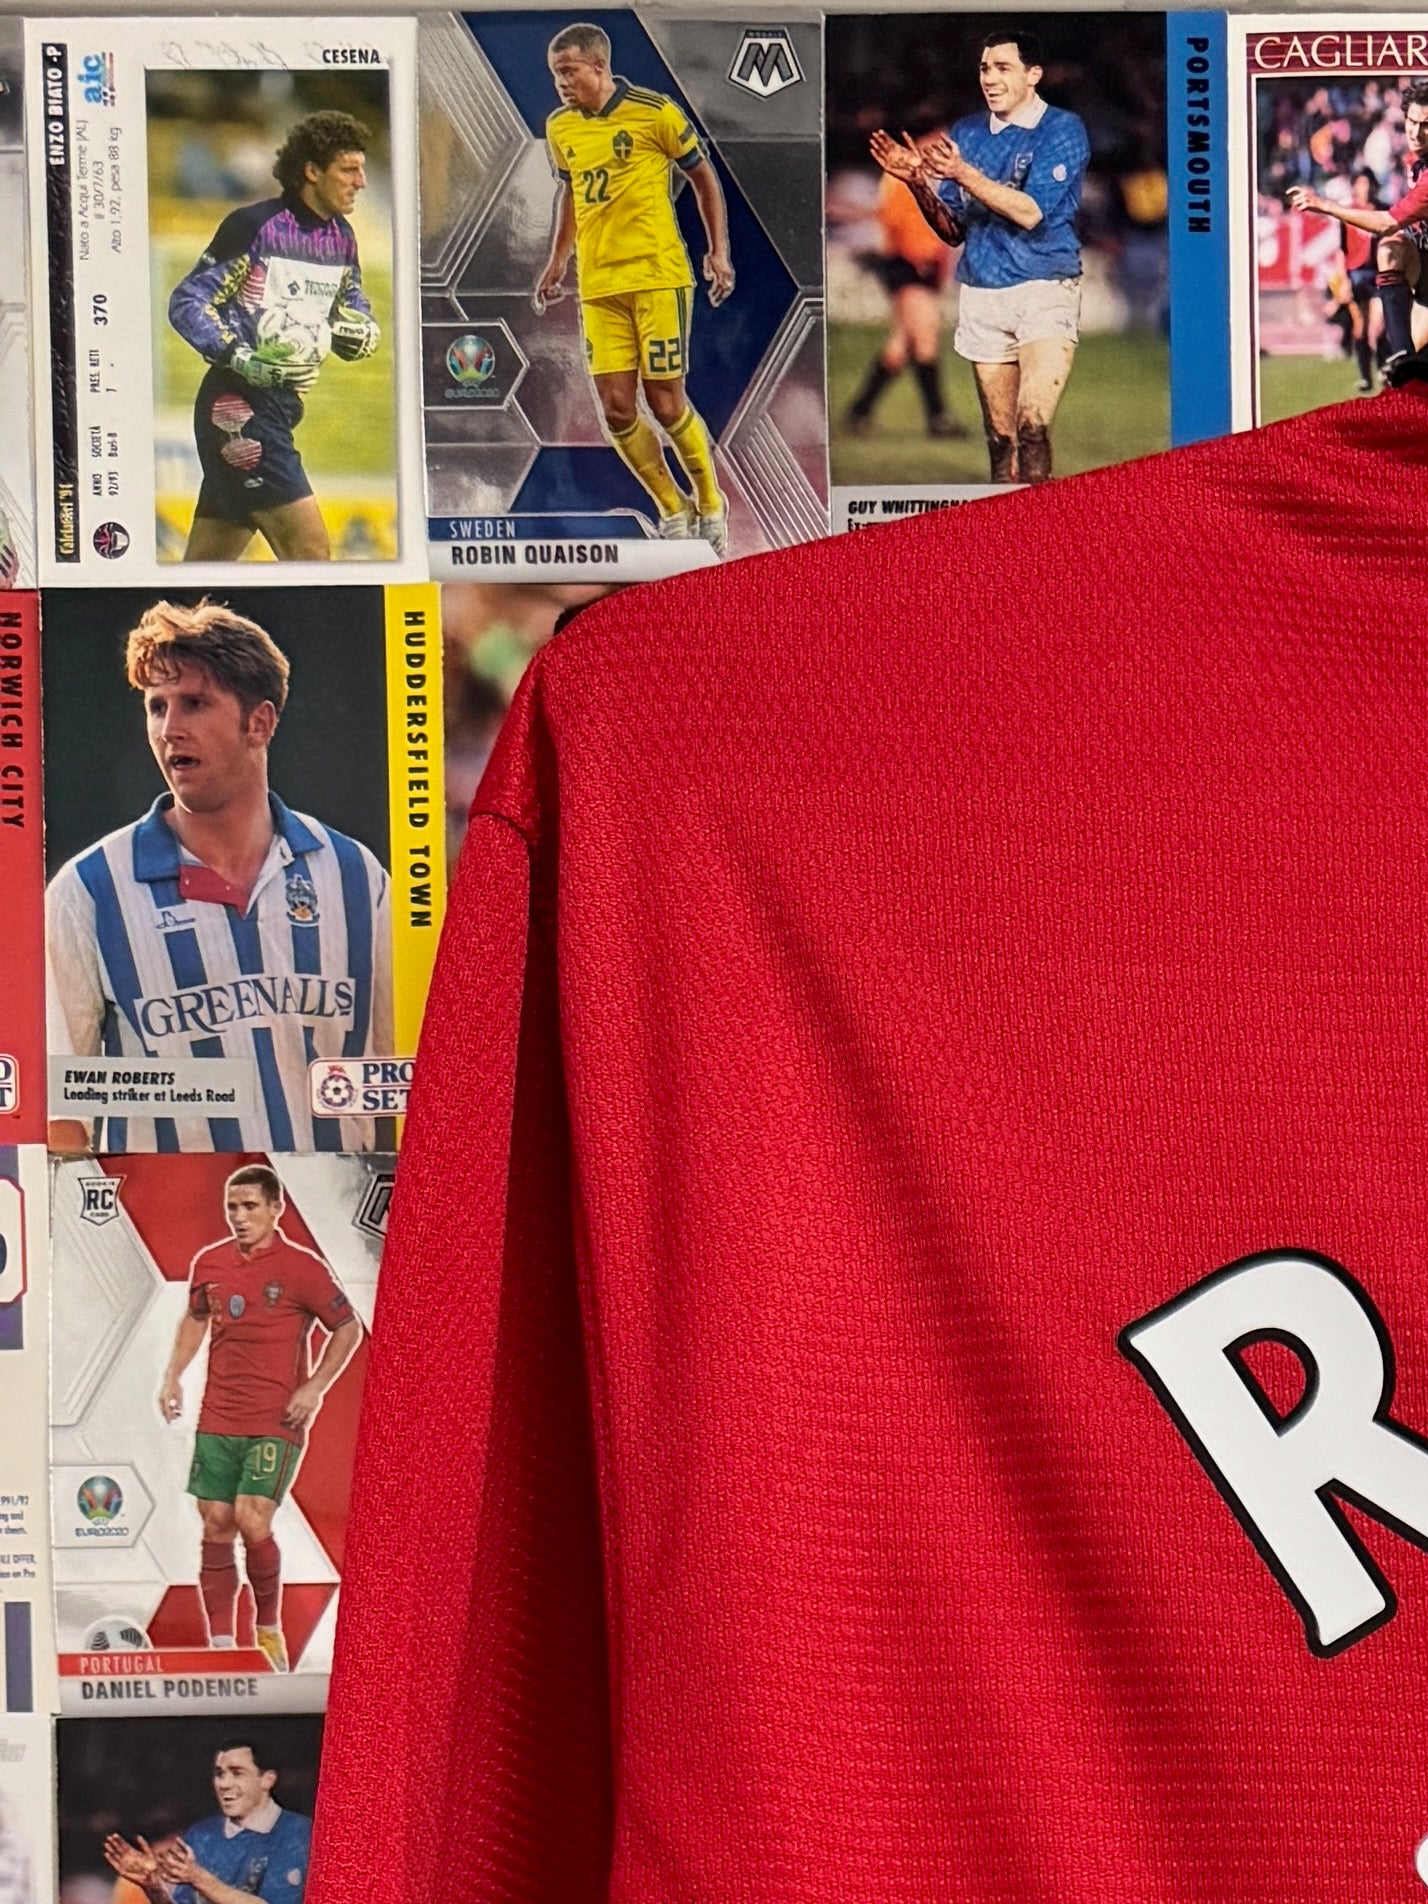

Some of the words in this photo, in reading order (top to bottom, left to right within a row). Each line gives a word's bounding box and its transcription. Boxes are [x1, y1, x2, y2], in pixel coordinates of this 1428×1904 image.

[322, 48, 381, 65] CESENA
[47, 68, 63, 114] BIATO
[48, 125, 65, 166] ENZO
[1187, 37, 1210, 234] PORTSMOUTH
[583, 170, 610, 204] 22
[93, 294, 108, 326] 370
[450, 520, 516, 538] SWEDEN
[451, 546, 518, 564] ROBIN
[525, 545, 618, 564] QUAISON
[1, 612, 23, 747] NORWICH
[404, 611, 428, 829] HUDDERSFIELD
[2, 765, 24, 829] CITY
[409, 847, 431, 928] TOWN
[141, 977, 353, 1040] GREENALLS
[64, 1070, 107, 1085] EWAN
[112, 1071, 175, 1085] ROBERTS
[64, 1088, 108, 1102] Leading
[112, 1088, 150, 1102] striker
[169, 1089, 203, 1101] Leeds
[80, 1655, 163, 1674] PORTUGAL
[82, 1680, 156, 1699] DANIEL
[163, 1678, 259, 1697] PODENCE
